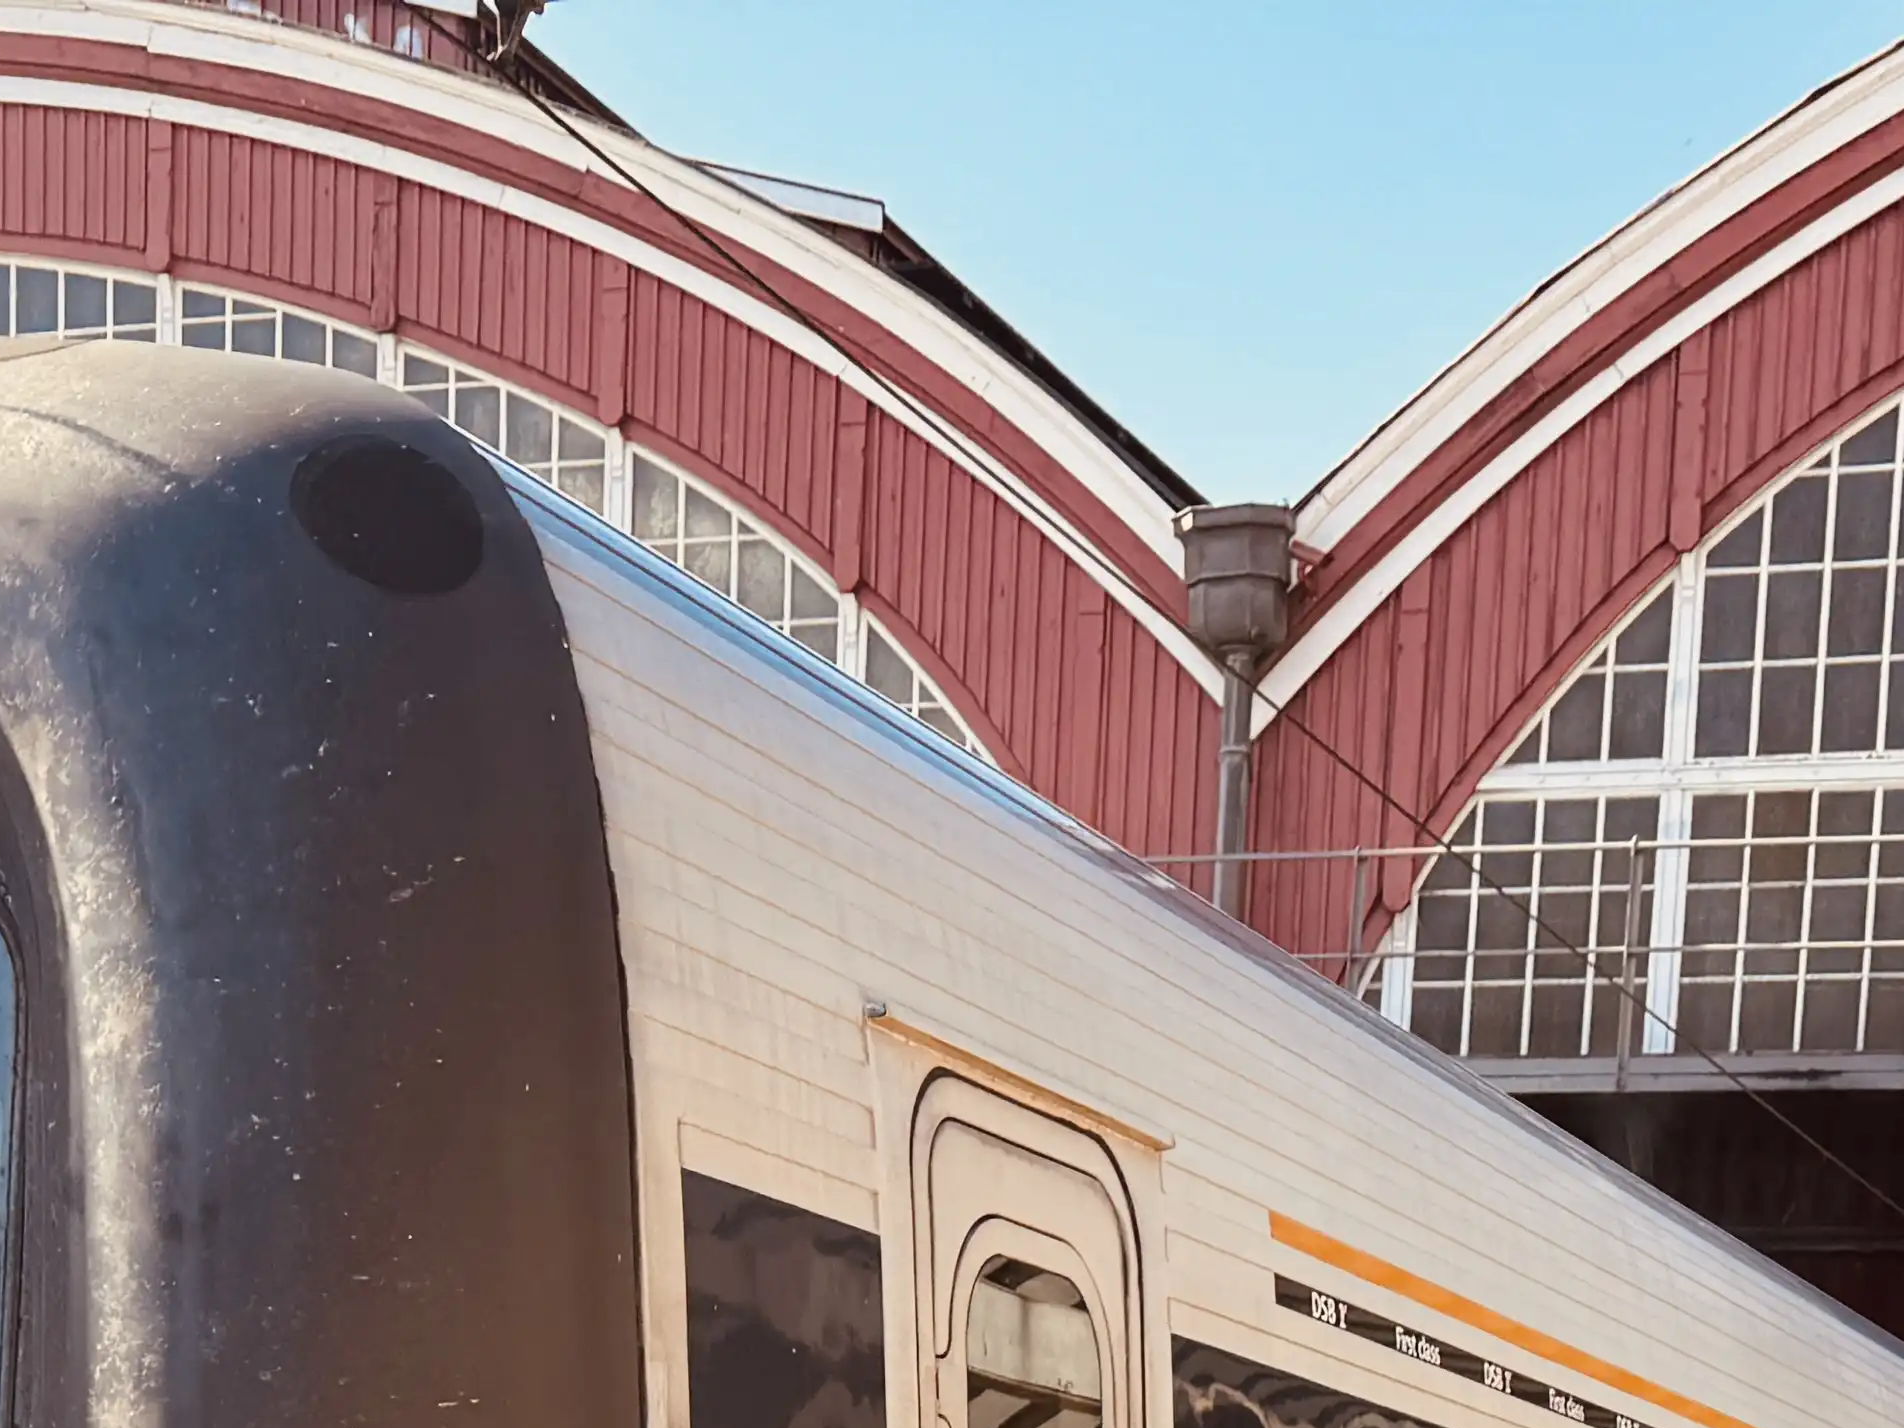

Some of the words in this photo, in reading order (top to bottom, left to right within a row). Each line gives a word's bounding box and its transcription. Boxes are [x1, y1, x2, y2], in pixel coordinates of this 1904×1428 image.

[1311, 1291, 1336, 1324] DSB
[1395, 1326, 1417, 1357] First
[1418, 1336, 1441, 1365] class
[1483, 1362, 1503, 1391] DSB
